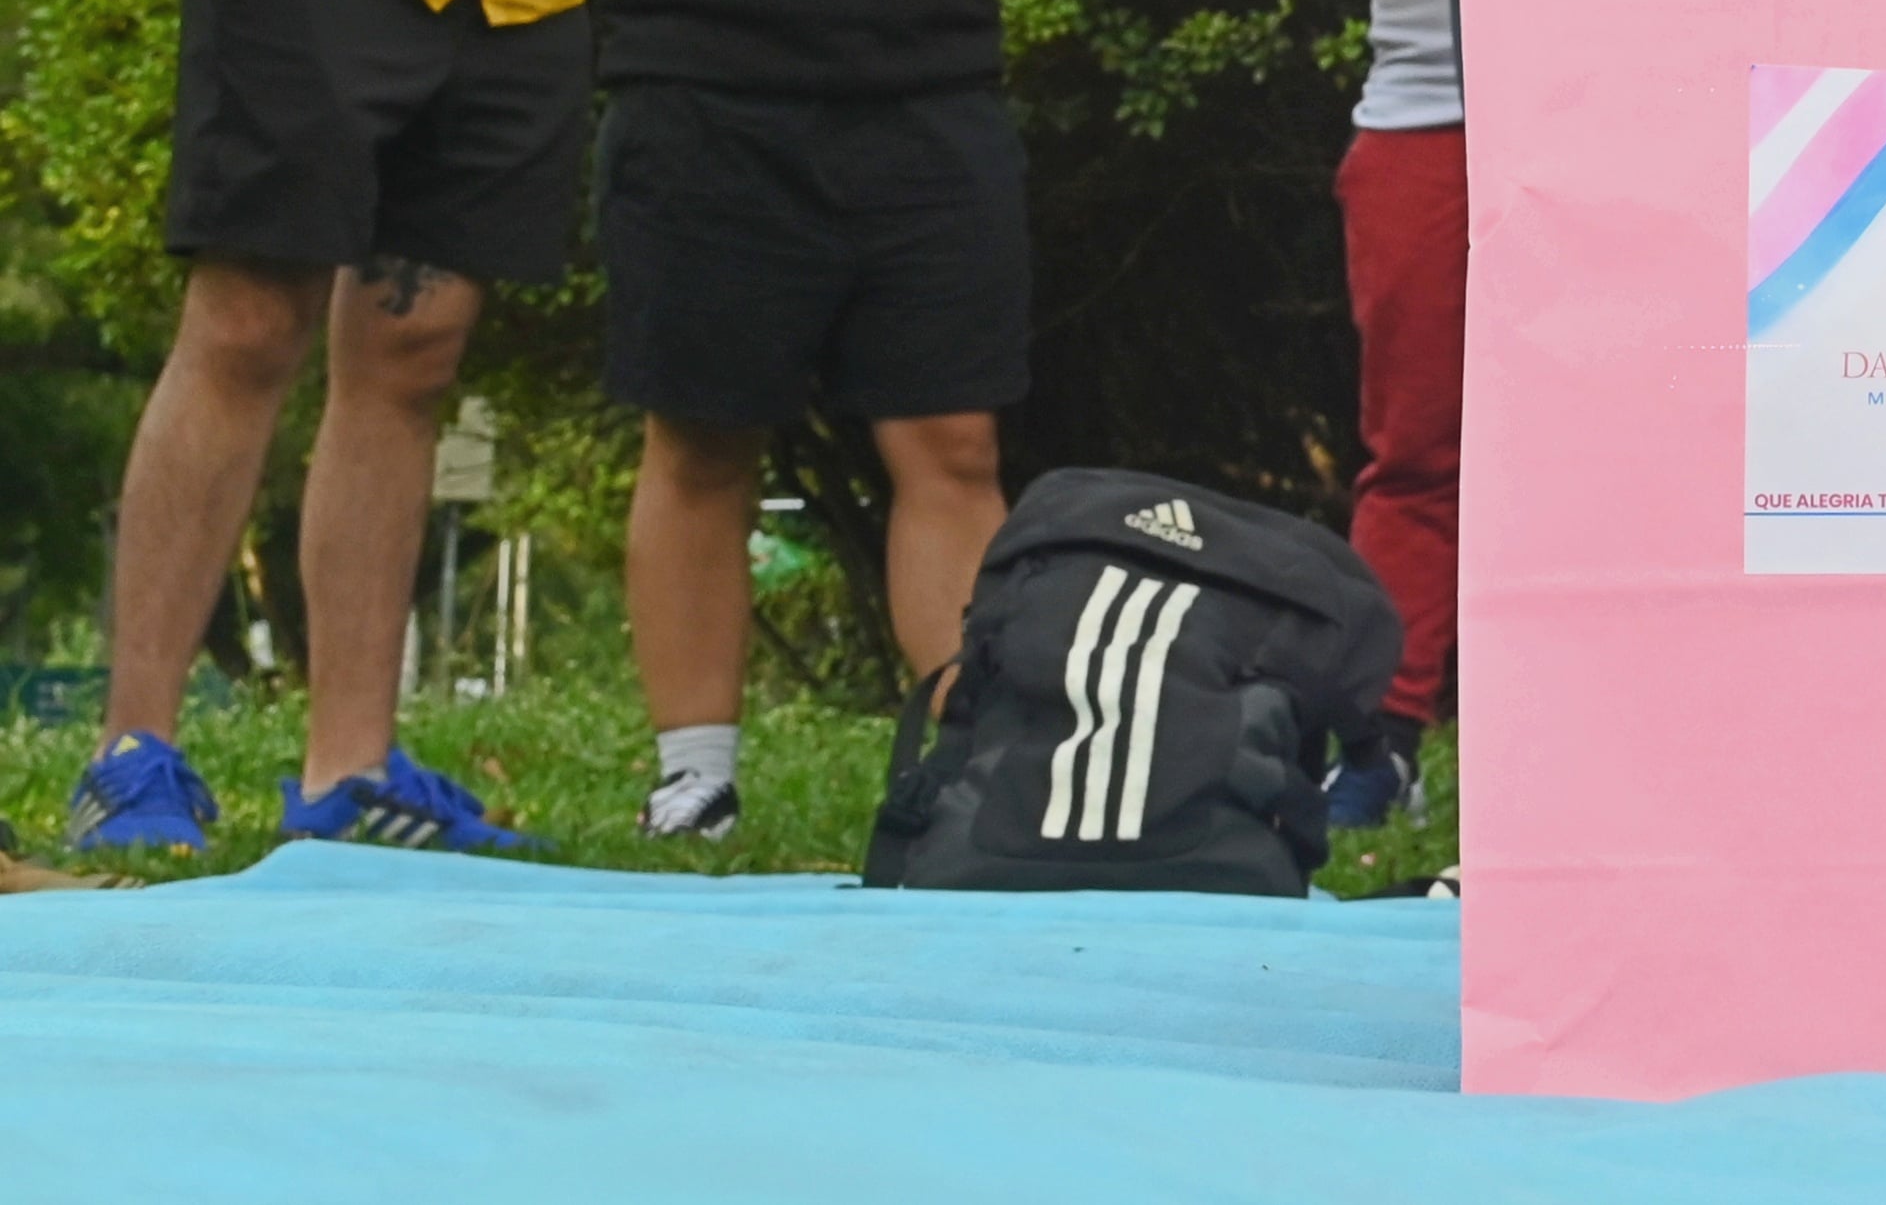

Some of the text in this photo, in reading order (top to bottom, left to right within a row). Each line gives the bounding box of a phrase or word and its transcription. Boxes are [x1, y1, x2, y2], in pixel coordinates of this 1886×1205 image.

[1754, 493, 1792, 509] QUE
[1796, 493, 1873, 509] ALEGRIA
[1124, 513, 1203, 552] adidas
